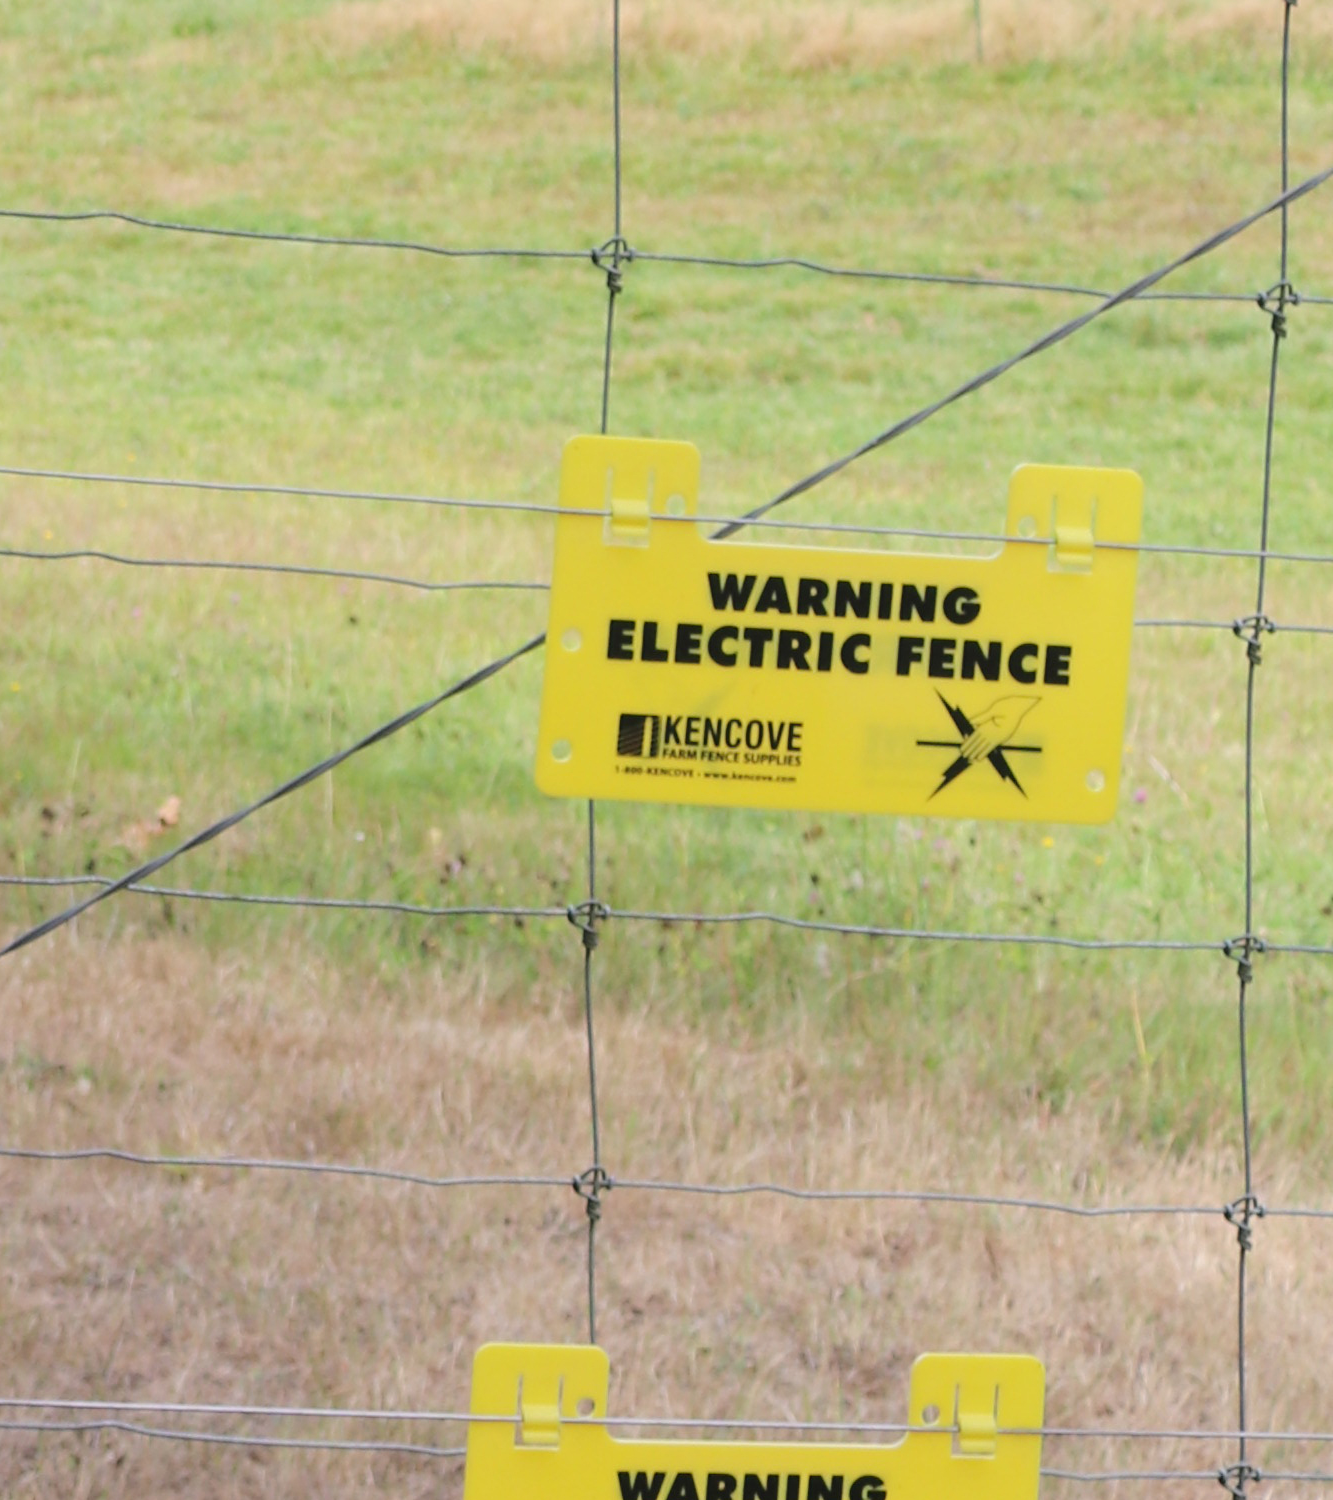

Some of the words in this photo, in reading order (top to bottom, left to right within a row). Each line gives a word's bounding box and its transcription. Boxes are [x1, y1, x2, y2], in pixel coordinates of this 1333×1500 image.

[707, 572, 981, 625] WARNING
[607, 619, 871, 674] ELECTRIC
[896, 636, 1072, 685] FENCE
[664, 716, 803, 751] KENCOVE
[662, 749, 697, 760] FARM
[701, 751, 739, 763] FENCE
[744, 754, 801, 766] SUPPLIES
